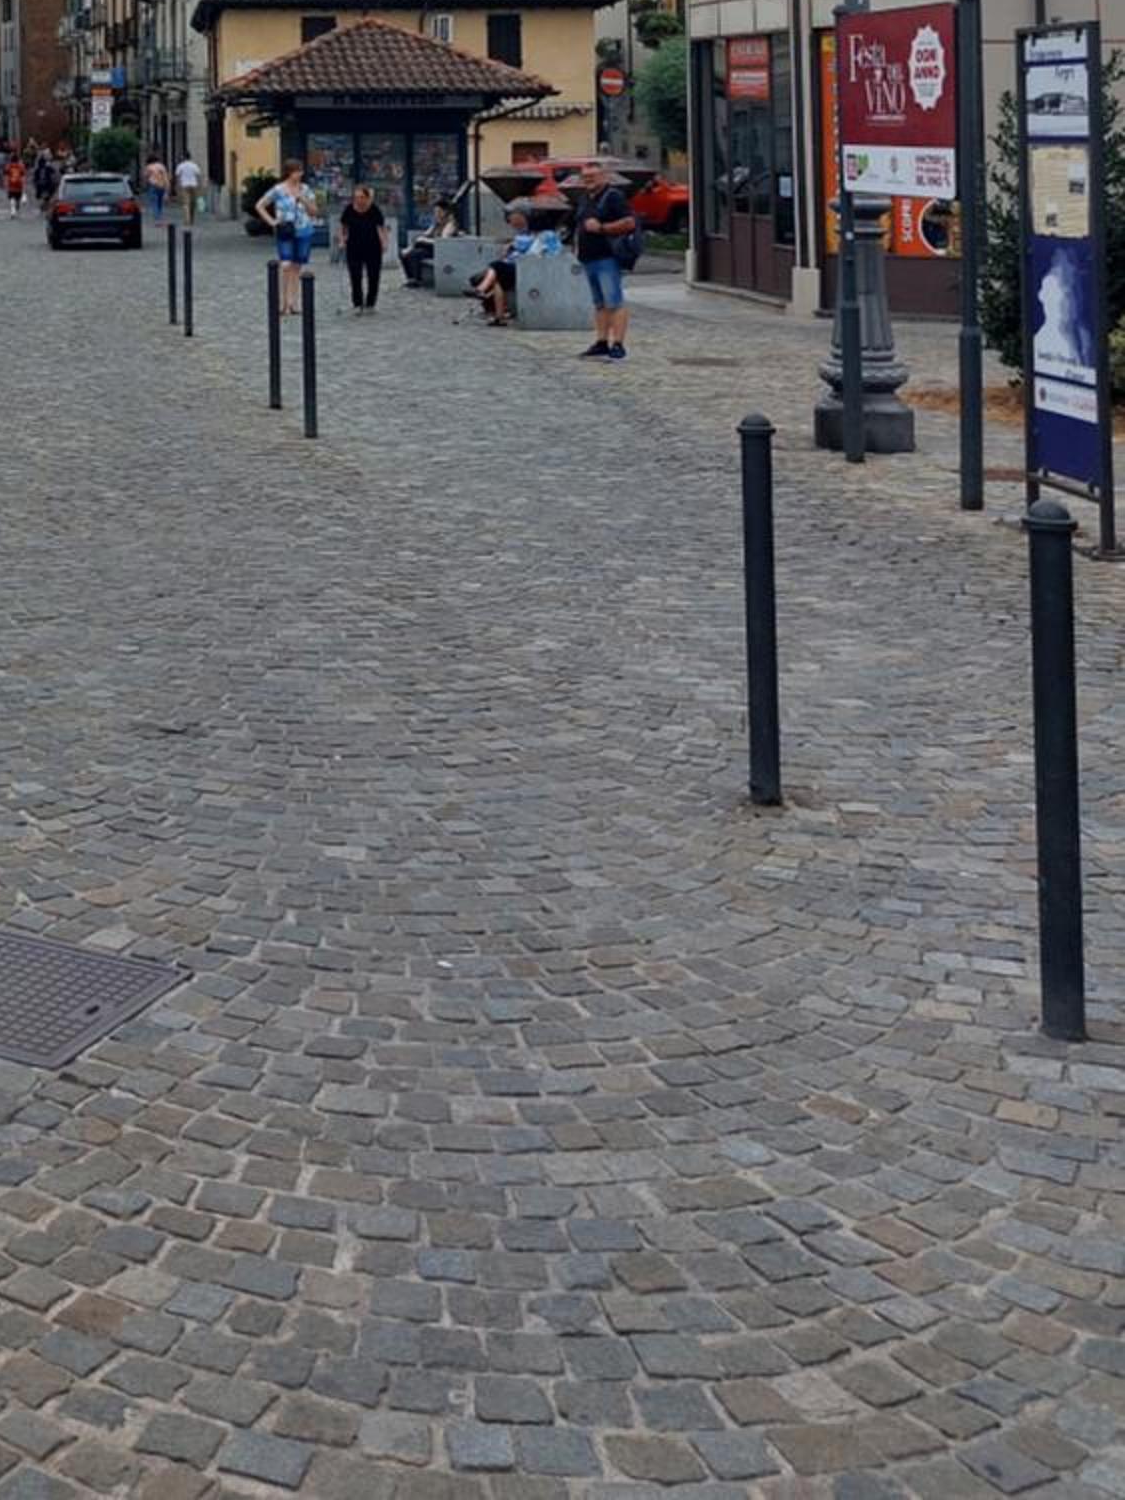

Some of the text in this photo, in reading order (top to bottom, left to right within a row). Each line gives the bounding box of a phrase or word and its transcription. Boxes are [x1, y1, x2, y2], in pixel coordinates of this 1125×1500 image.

[915, 48, 938, 64] OGNI
[914, 65, 941, 80] ANNO
[864, 80, 906, 114] VINO
